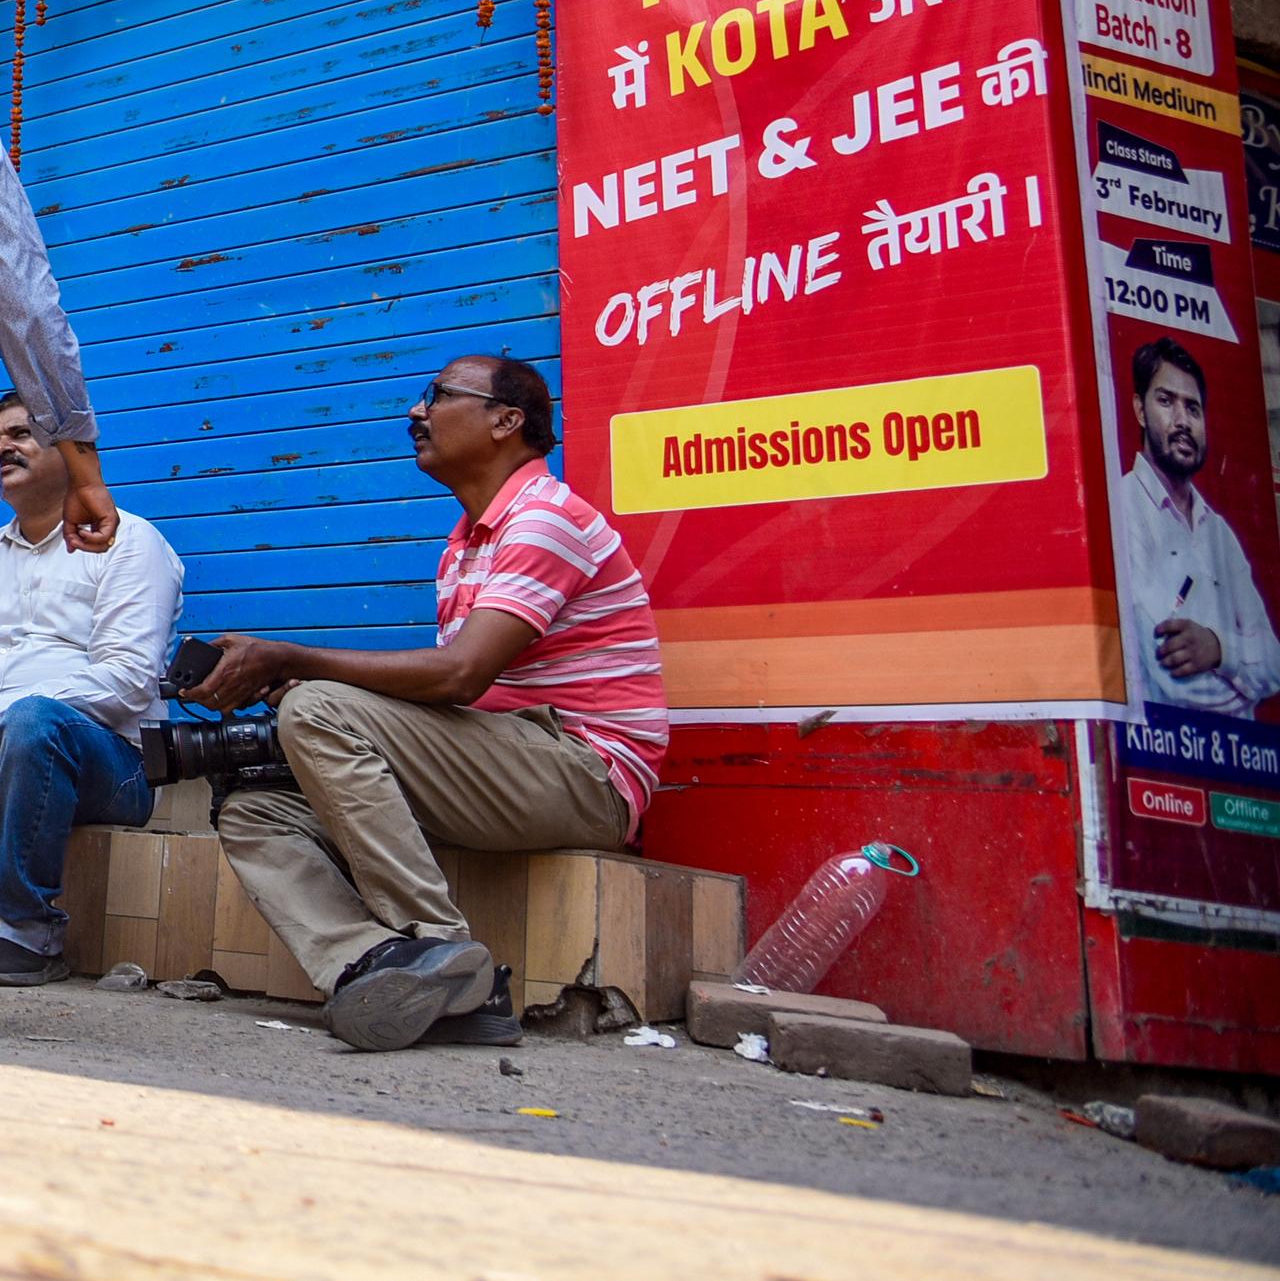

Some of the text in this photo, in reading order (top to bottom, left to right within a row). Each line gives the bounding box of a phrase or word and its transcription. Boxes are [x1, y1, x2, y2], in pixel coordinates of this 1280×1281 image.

[1095, 3, 1158, 51] Batch
[1175, 28, 1192, 59] 8
[607, 40, 649, 109] में
[1134, 77, 1217, 122] Medium
[573, 37, 1049, 238] NEET & JEE की
[1105, 139, 1173, 170] Class Starts
[1096, 176, 1122, 199] 3rd
[1129, 185, 1223, 234] February
[594, 231, 842, 347] OFFLINE
[861, 172, 1008, 270] तैयारी
[1152, 245, 1192, 272] Time
[1104, 276, 1210, 323] 12:00 PM
[662, 407, 982, 478] Admissions Open
[1126, 723, 1278, 774] Khan Sir & Team
[1142, 790, 1270, 821] Online Offline
